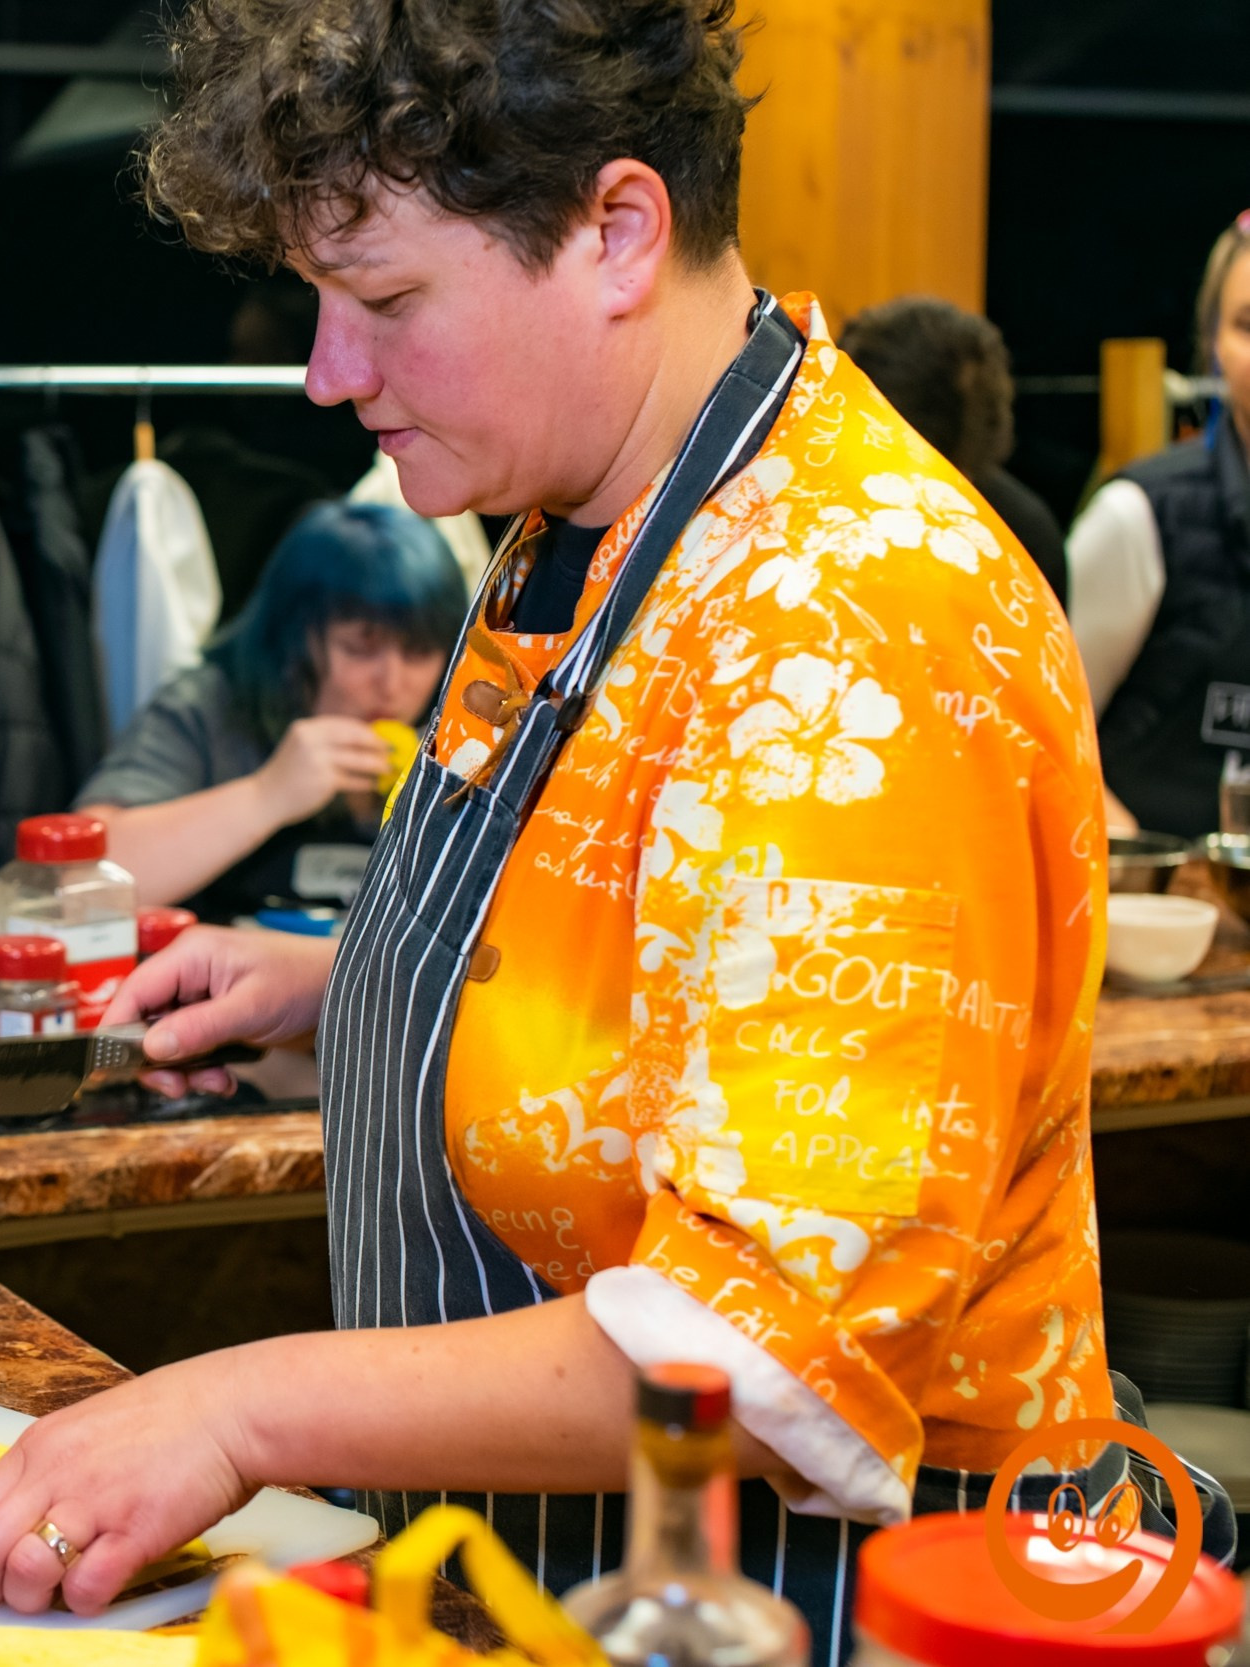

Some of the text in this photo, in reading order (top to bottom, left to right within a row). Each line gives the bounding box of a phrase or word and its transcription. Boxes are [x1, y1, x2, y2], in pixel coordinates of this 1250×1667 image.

[735, 1020, 868, 1062] CALLS
[774, 1075, 850, 1122] FOR
[645, 1234, 700, 1290] be
